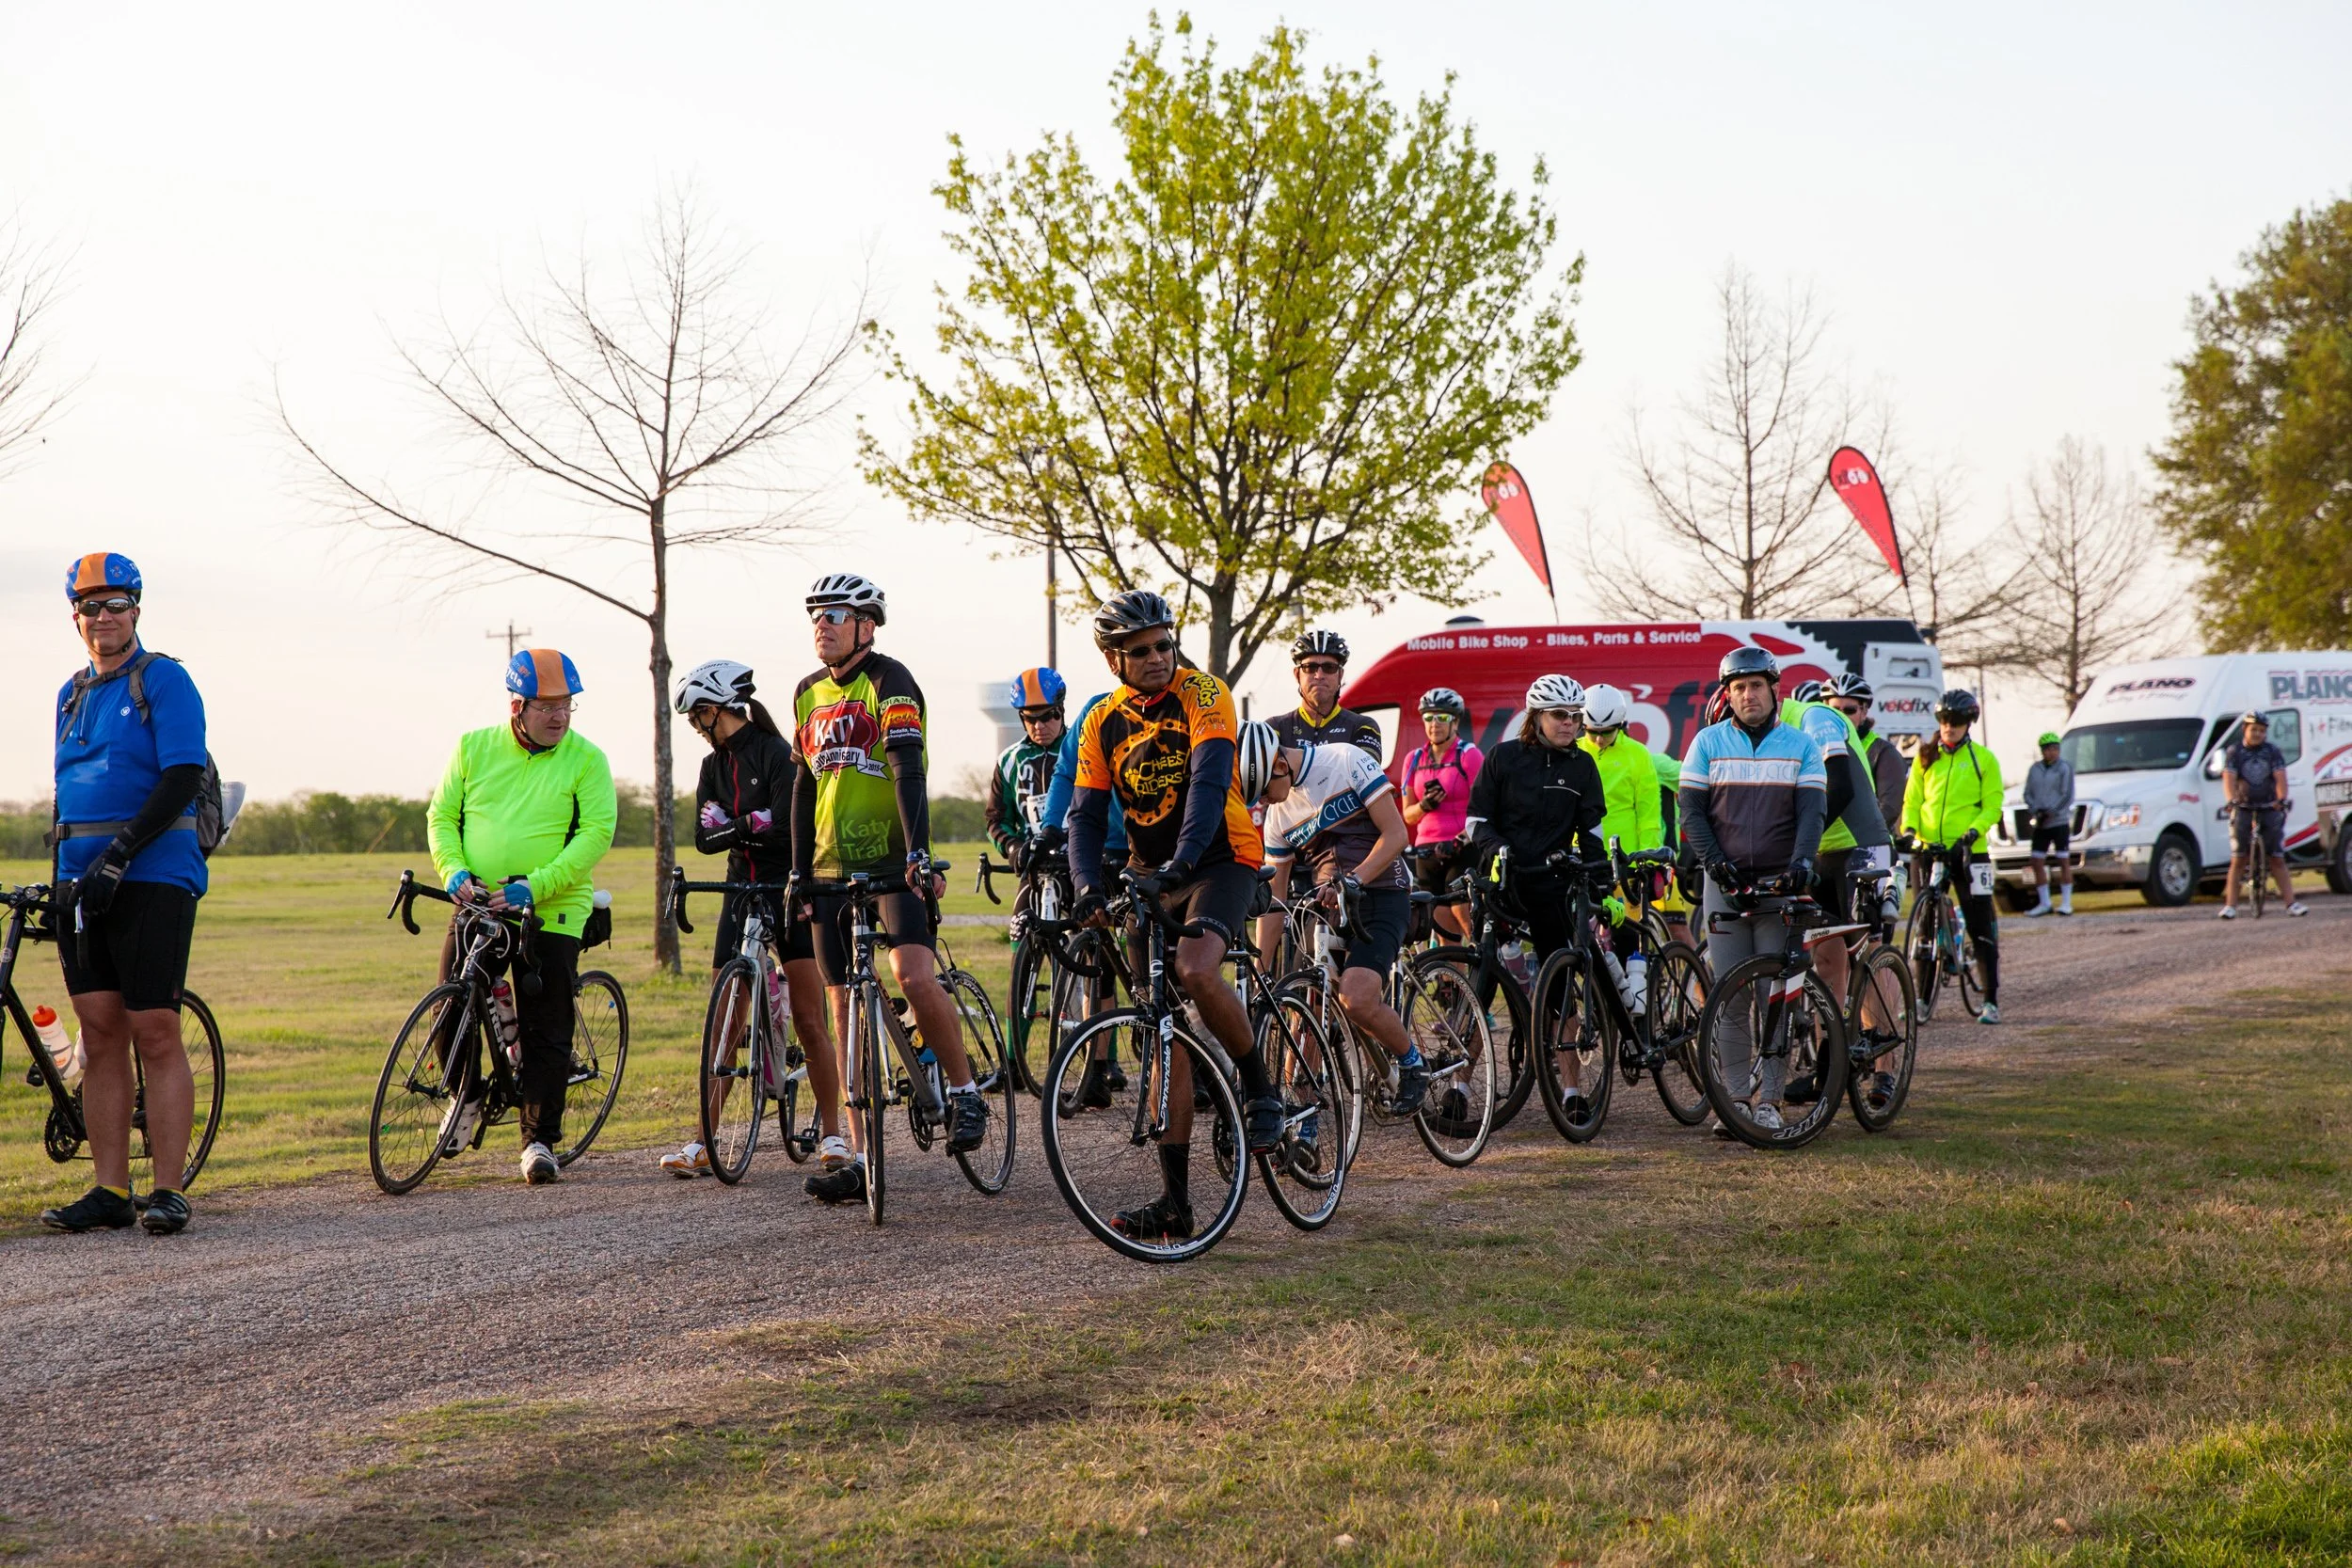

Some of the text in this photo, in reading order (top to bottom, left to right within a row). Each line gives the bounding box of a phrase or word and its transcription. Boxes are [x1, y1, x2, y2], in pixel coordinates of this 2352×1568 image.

[1407, 637, 1454, 651] Mobile
[1458, 635, 1489, 649] Bike
[1493, 634, 1529, 649] Shop
[1547, 633, 1589, 647] Bikes,
[1593, 631, 1630, 645] Parts
[1633, 631, 1645, 644] &
[1649, 630, 1702, 644] Service
[1135, 771, 1184, 798] RIDERS
[1323, 793, 1359, 821] CYCLE
[840, 819, 892, 840] Katy
[842, 838, 890, 860] Trail
